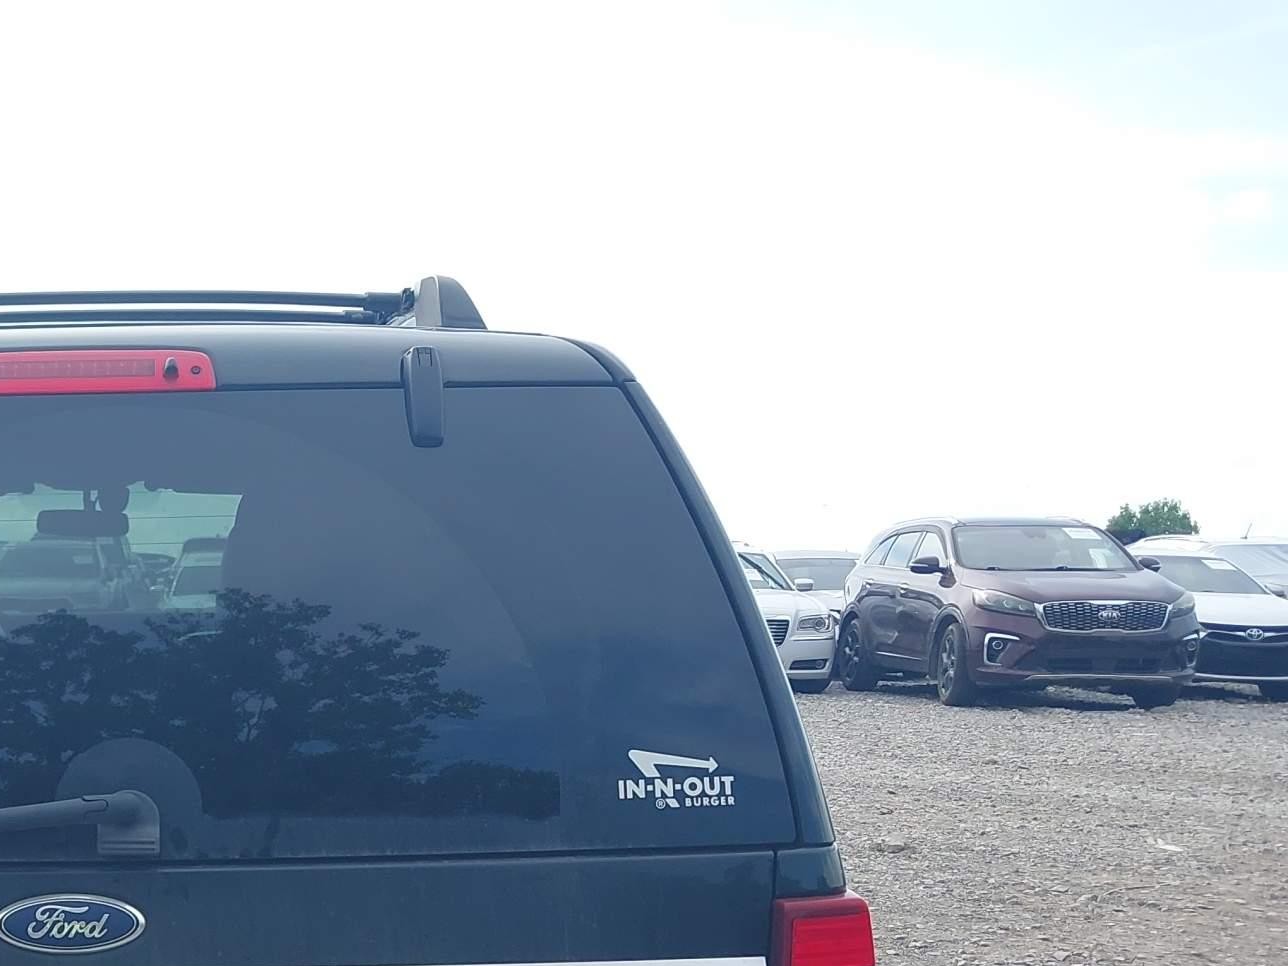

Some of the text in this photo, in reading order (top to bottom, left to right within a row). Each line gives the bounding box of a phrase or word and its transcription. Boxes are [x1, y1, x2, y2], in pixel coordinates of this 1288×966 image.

[618, 776, 735, 799] IN-N-OUT
[685, 796, 735, 807] BURGER
[27, 904, 110, 939] Ford
